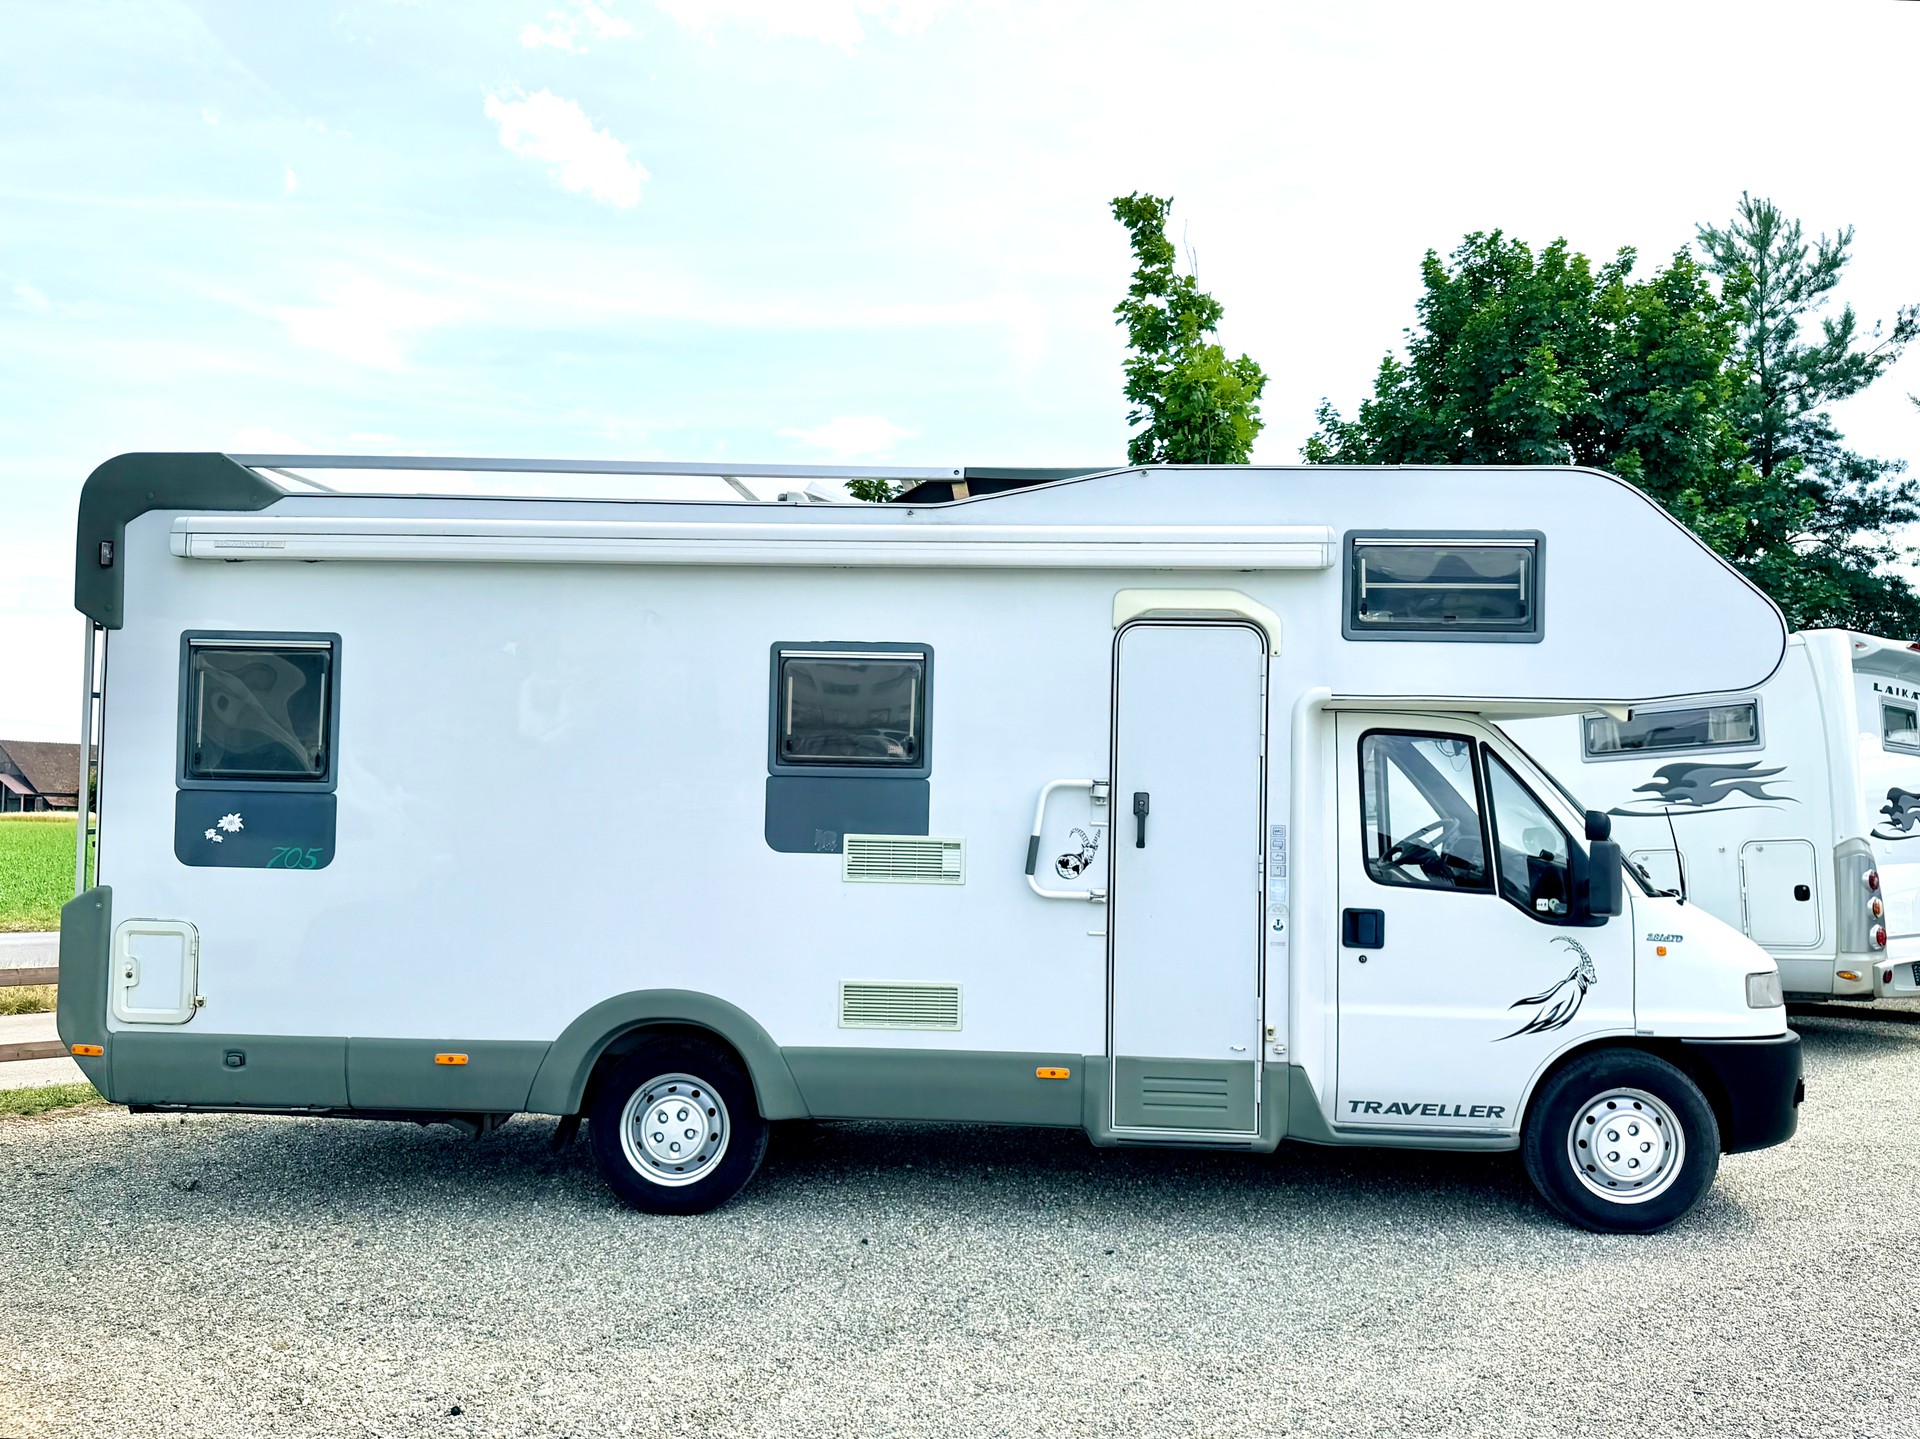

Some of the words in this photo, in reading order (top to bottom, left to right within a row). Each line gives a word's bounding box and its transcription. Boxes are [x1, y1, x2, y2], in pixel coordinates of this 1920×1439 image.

[1873, 682, 1920, 700] LAIKA
[265, 846, 324, 869] 705
[1348, 1100, 1506, 1119] TRAVELLER
